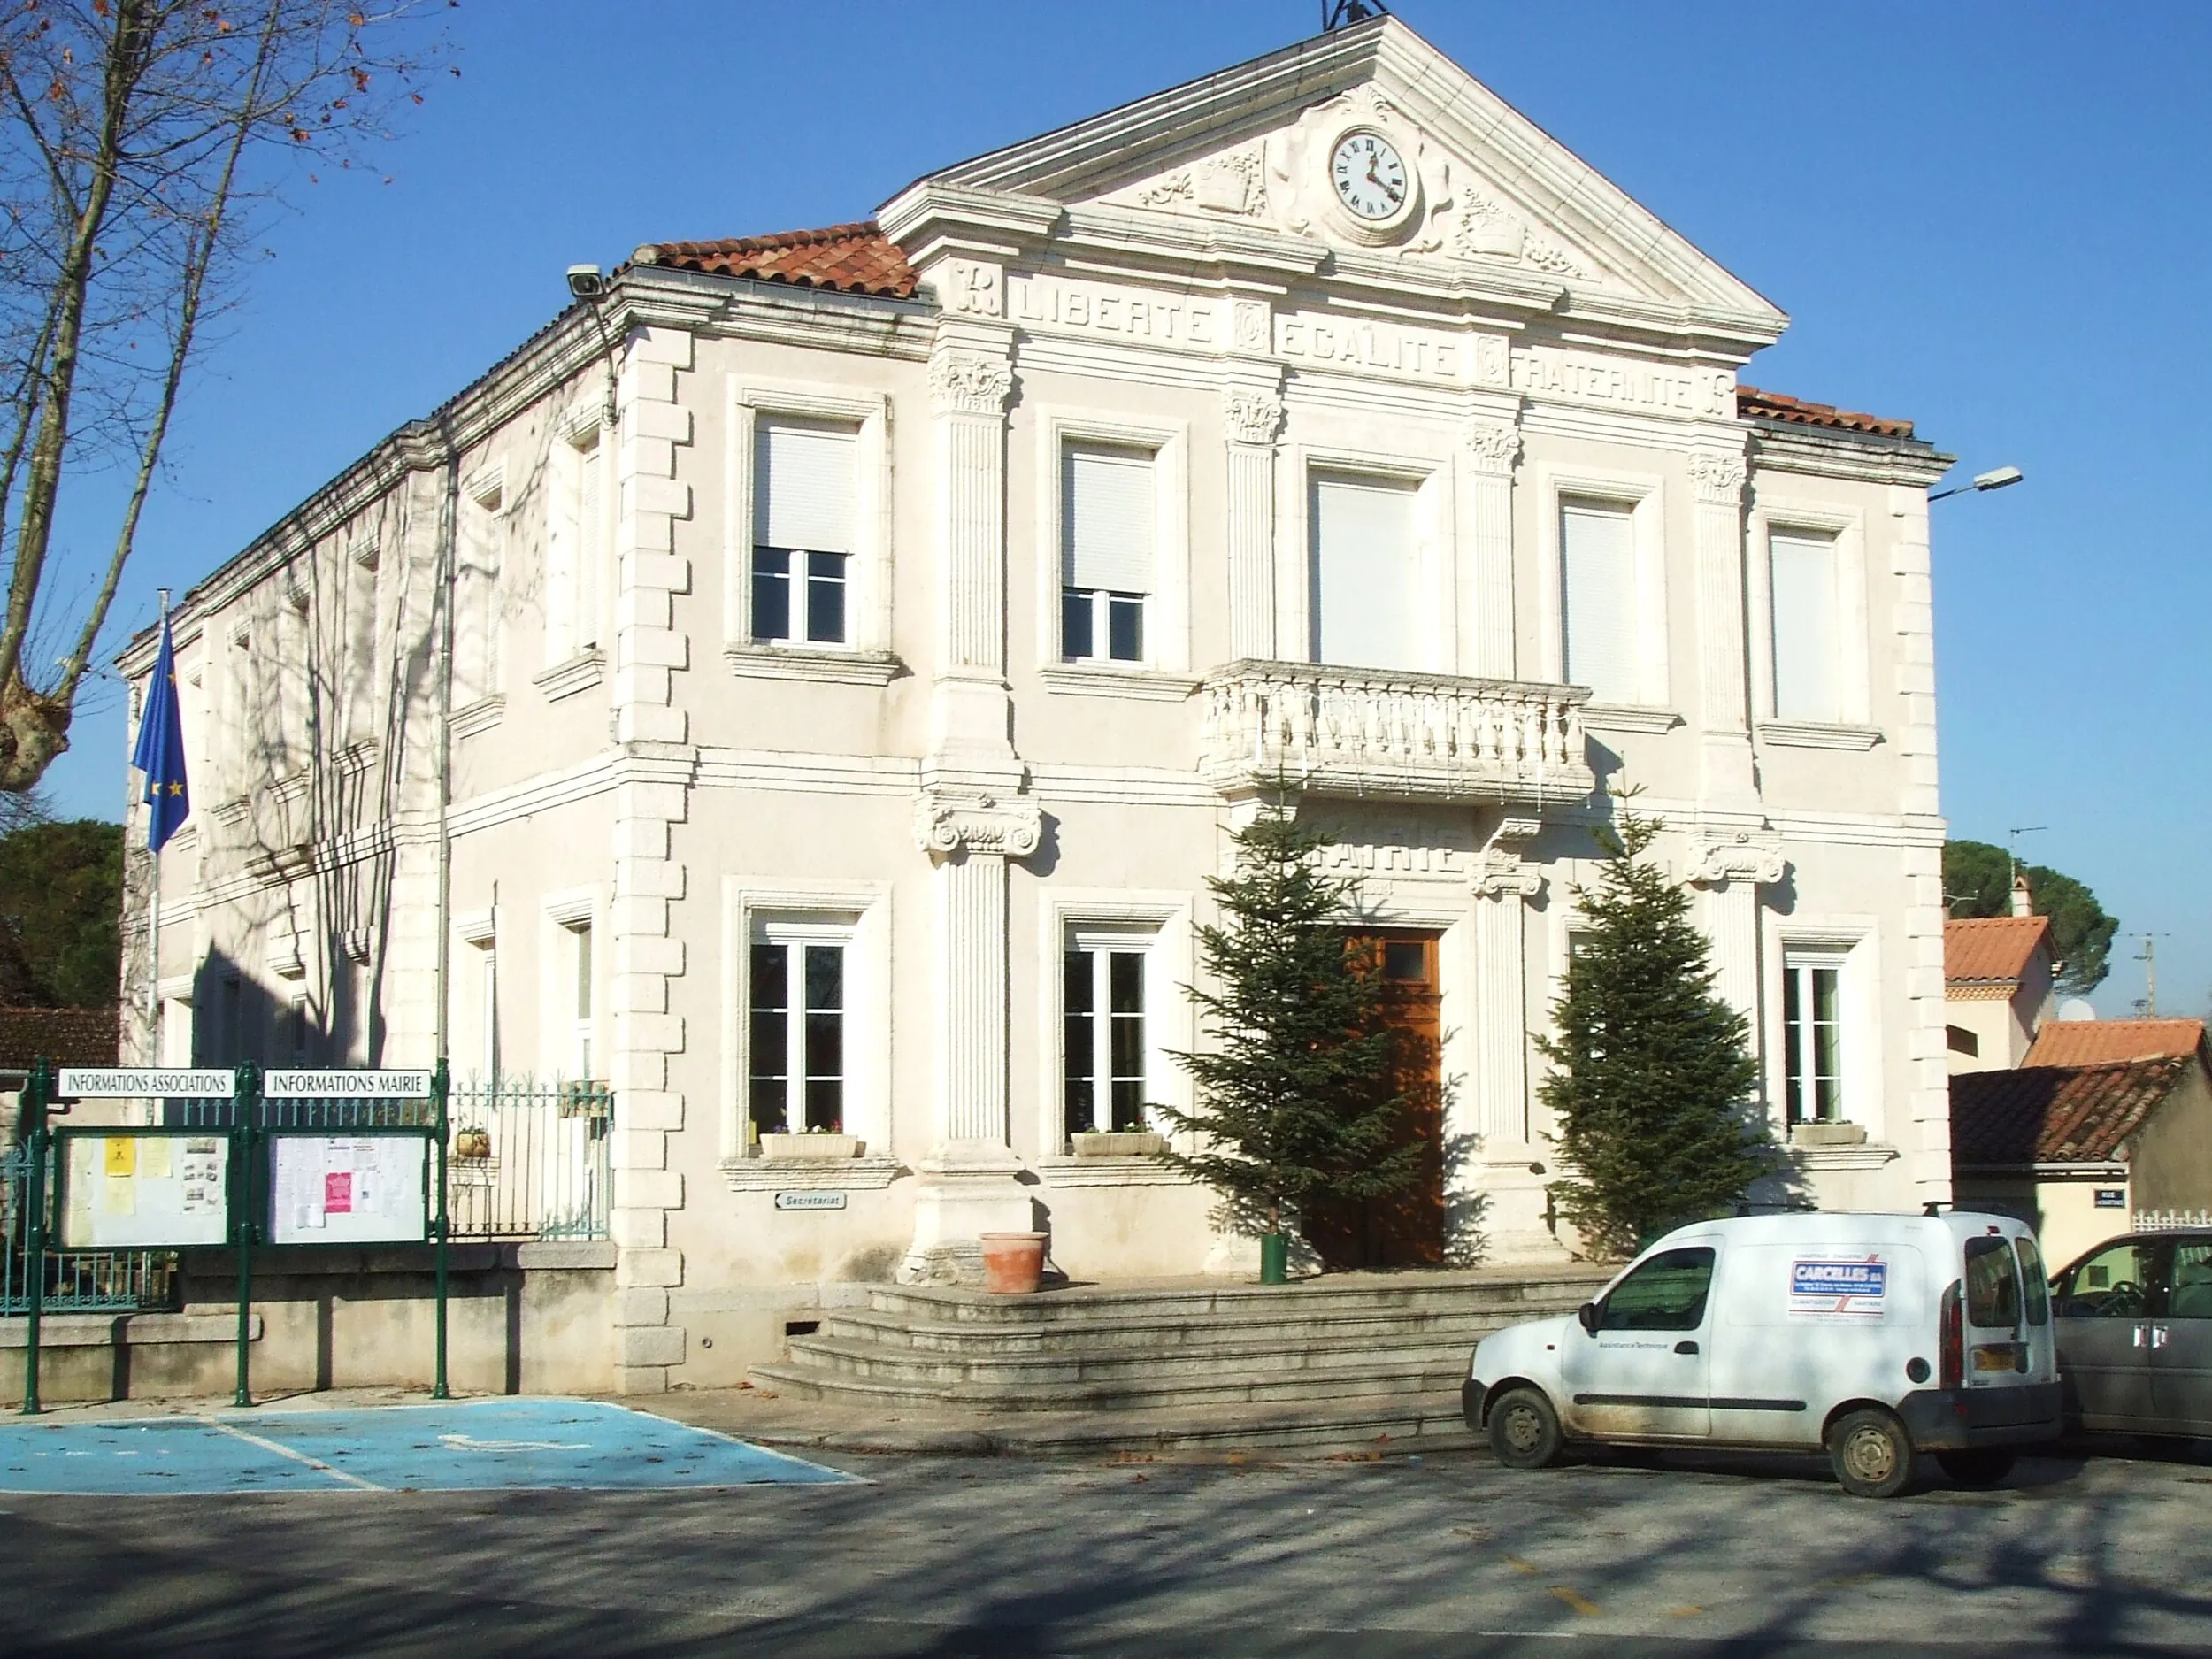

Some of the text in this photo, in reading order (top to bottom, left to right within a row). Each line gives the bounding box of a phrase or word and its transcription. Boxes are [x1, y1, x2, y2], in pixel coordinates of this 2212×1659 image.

[1017, 280, 1212, 343] LIBERTE
[68, 1074, 227, 1093] INFORMATIONS ASSOCIATIONS
[273, 1075, 422, 1093] INFORMATIONS MAIRIE
[1795, 1265, 1870, 1282] CARCELLES
